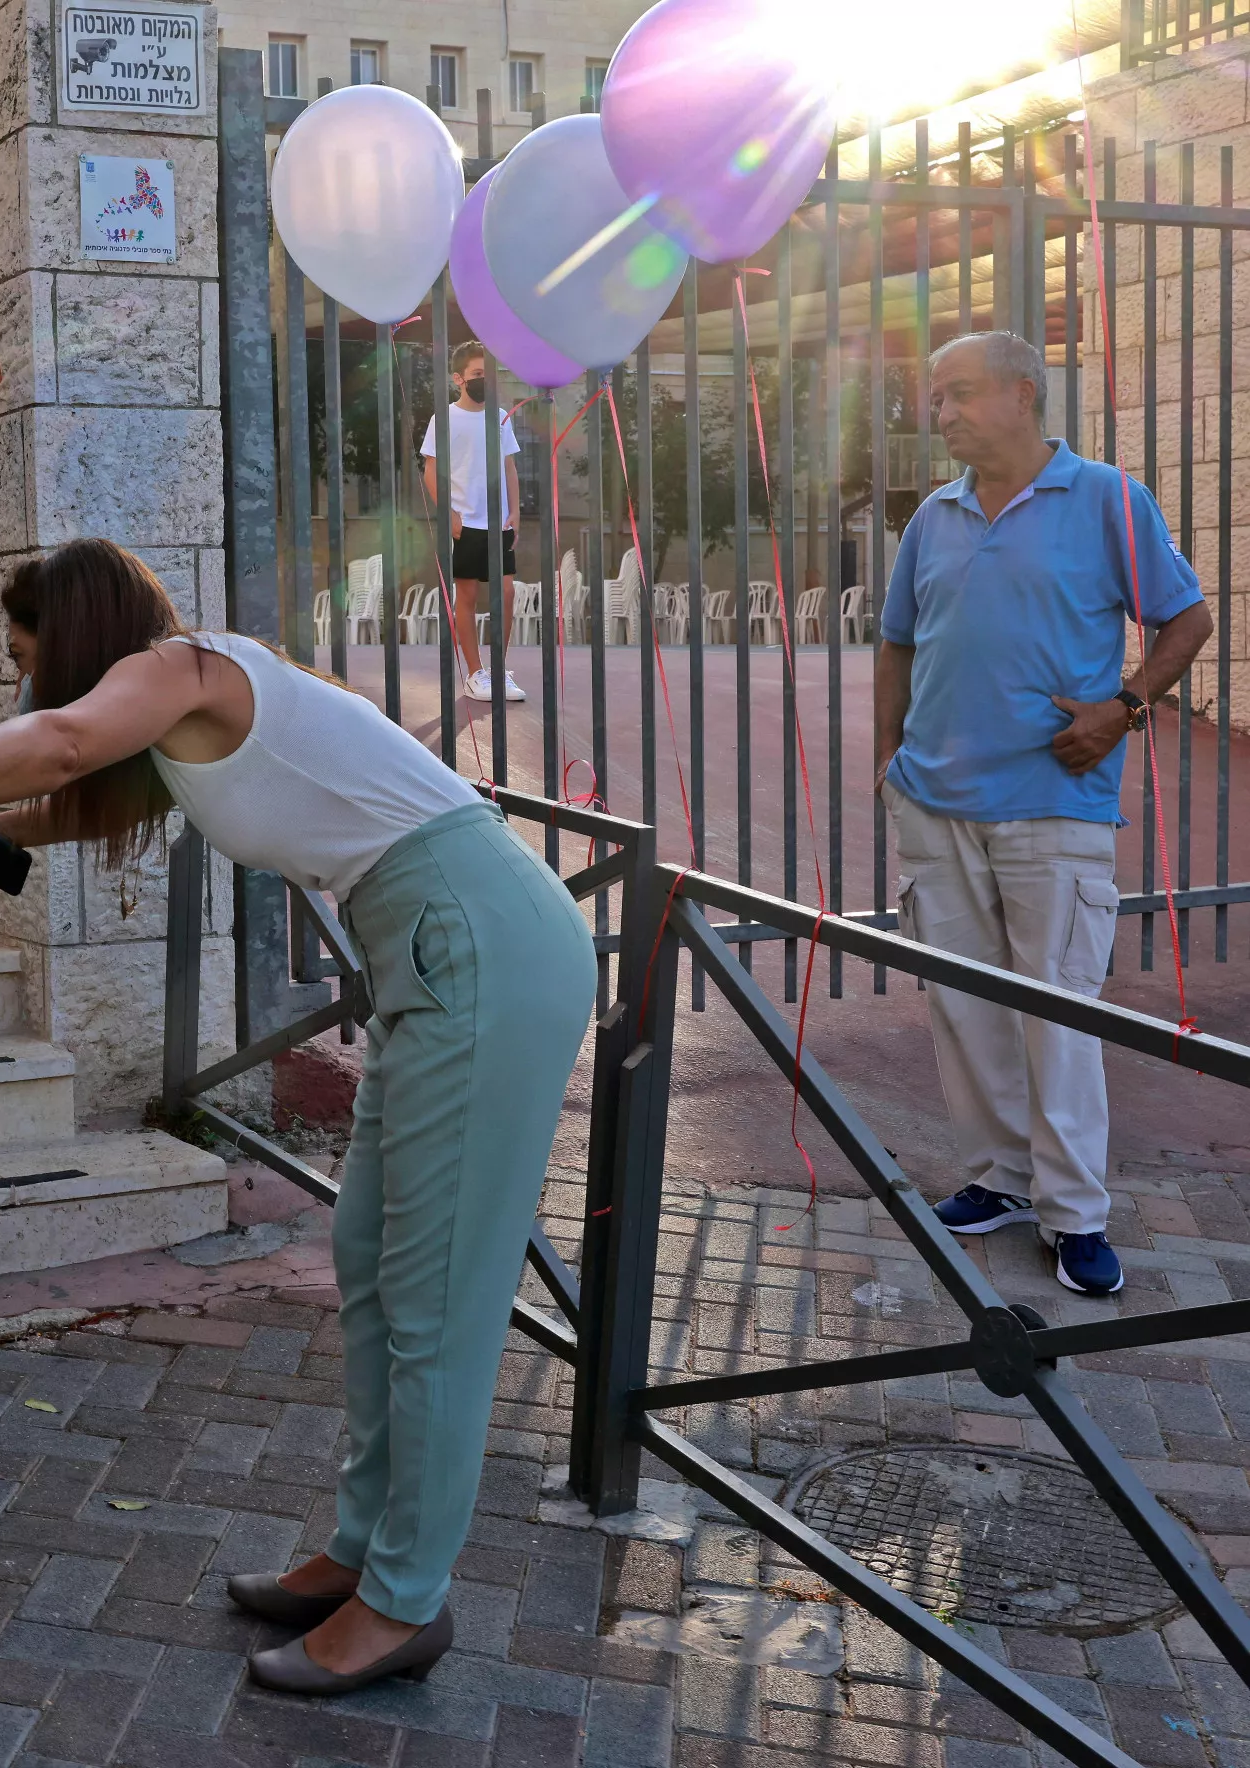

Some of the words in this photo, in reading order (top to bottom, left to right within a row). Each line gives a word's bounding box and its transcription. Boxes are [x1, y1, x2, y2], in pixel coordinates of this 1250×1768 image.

[73, 13, 135, 36] מאובטח
[141, 17, 192, 43] המקום
[141, 44, 167, 59] ע"י
[111, 59, 191, 82] מצלמות
[76, 84, 141, 102] ונסתרות
[147, 86, 192, 105] גלויות
